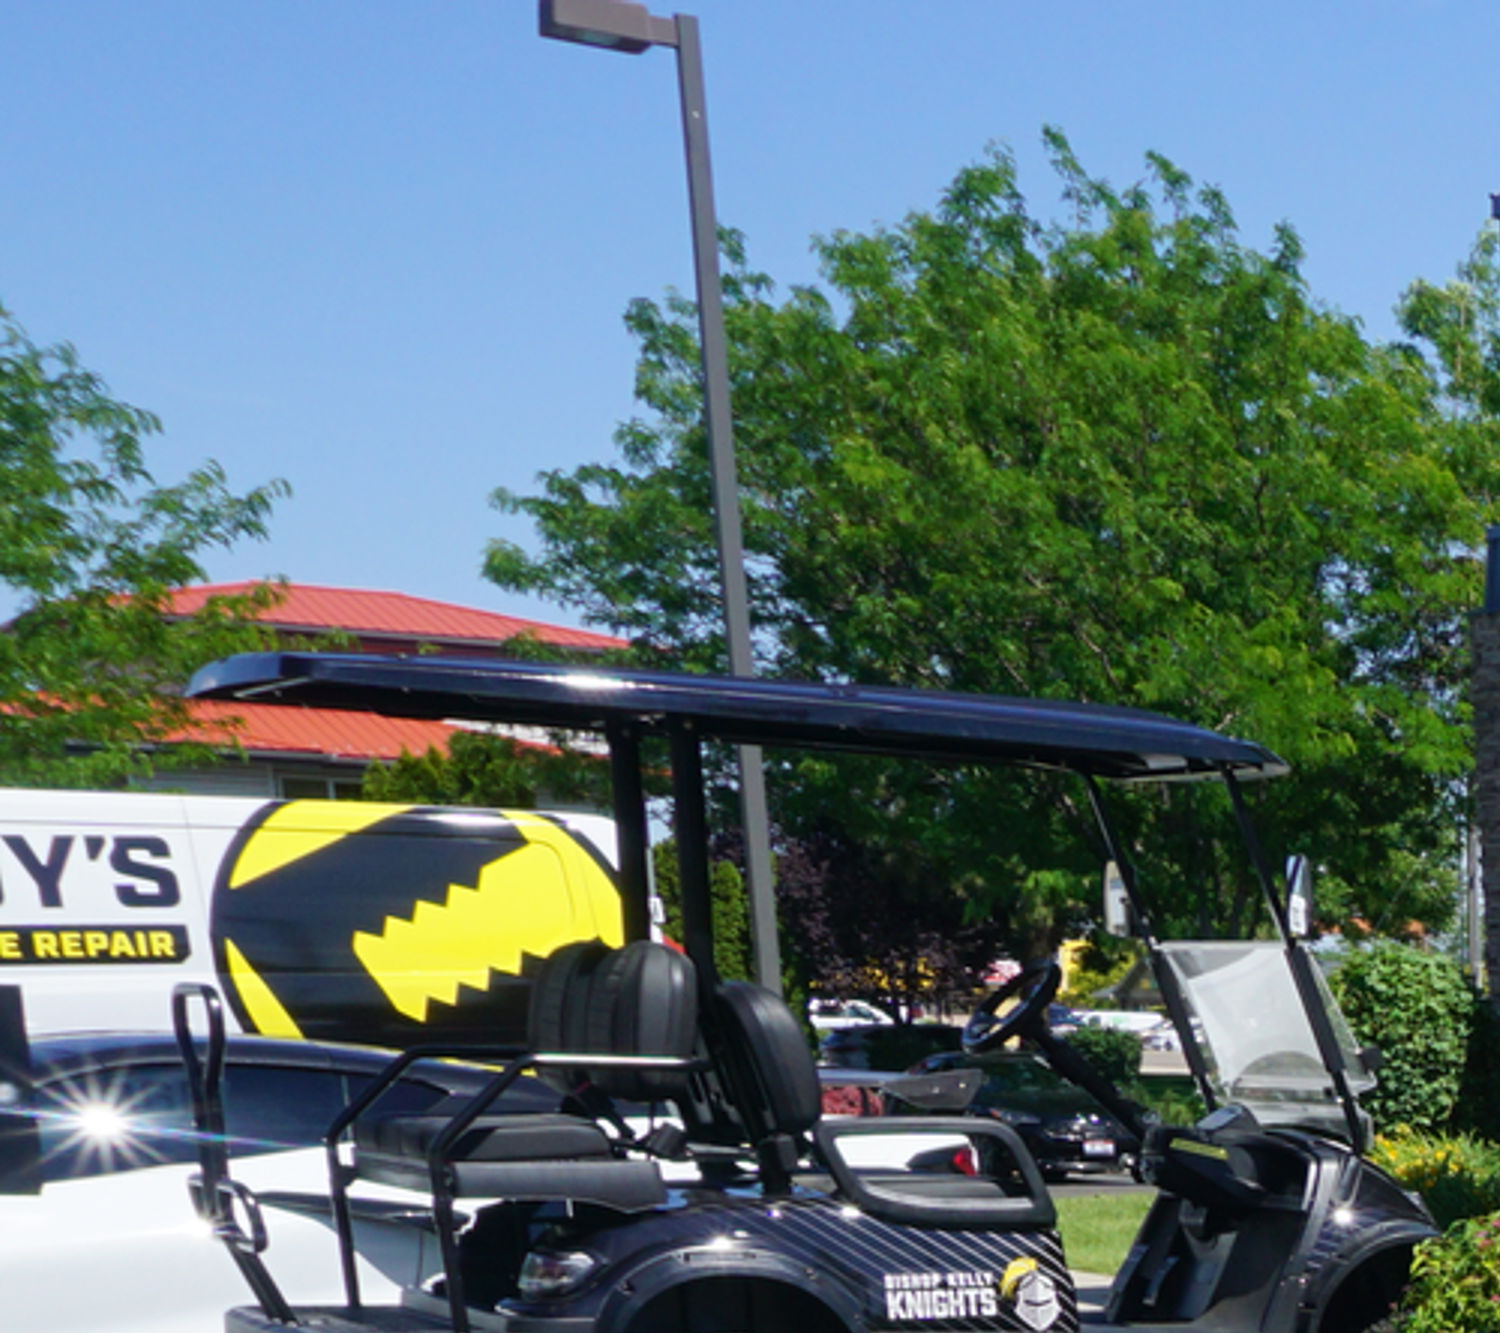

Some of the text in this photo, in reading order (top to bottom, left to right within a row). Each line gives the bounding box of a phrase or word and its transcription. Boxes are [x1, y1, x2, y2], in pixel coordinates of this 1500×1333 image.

[0, 834, 181, 908] Y'S
[31, 930, 177, 960] REPAIR
[885, 1287, 998, 1321] KNIGHTS
